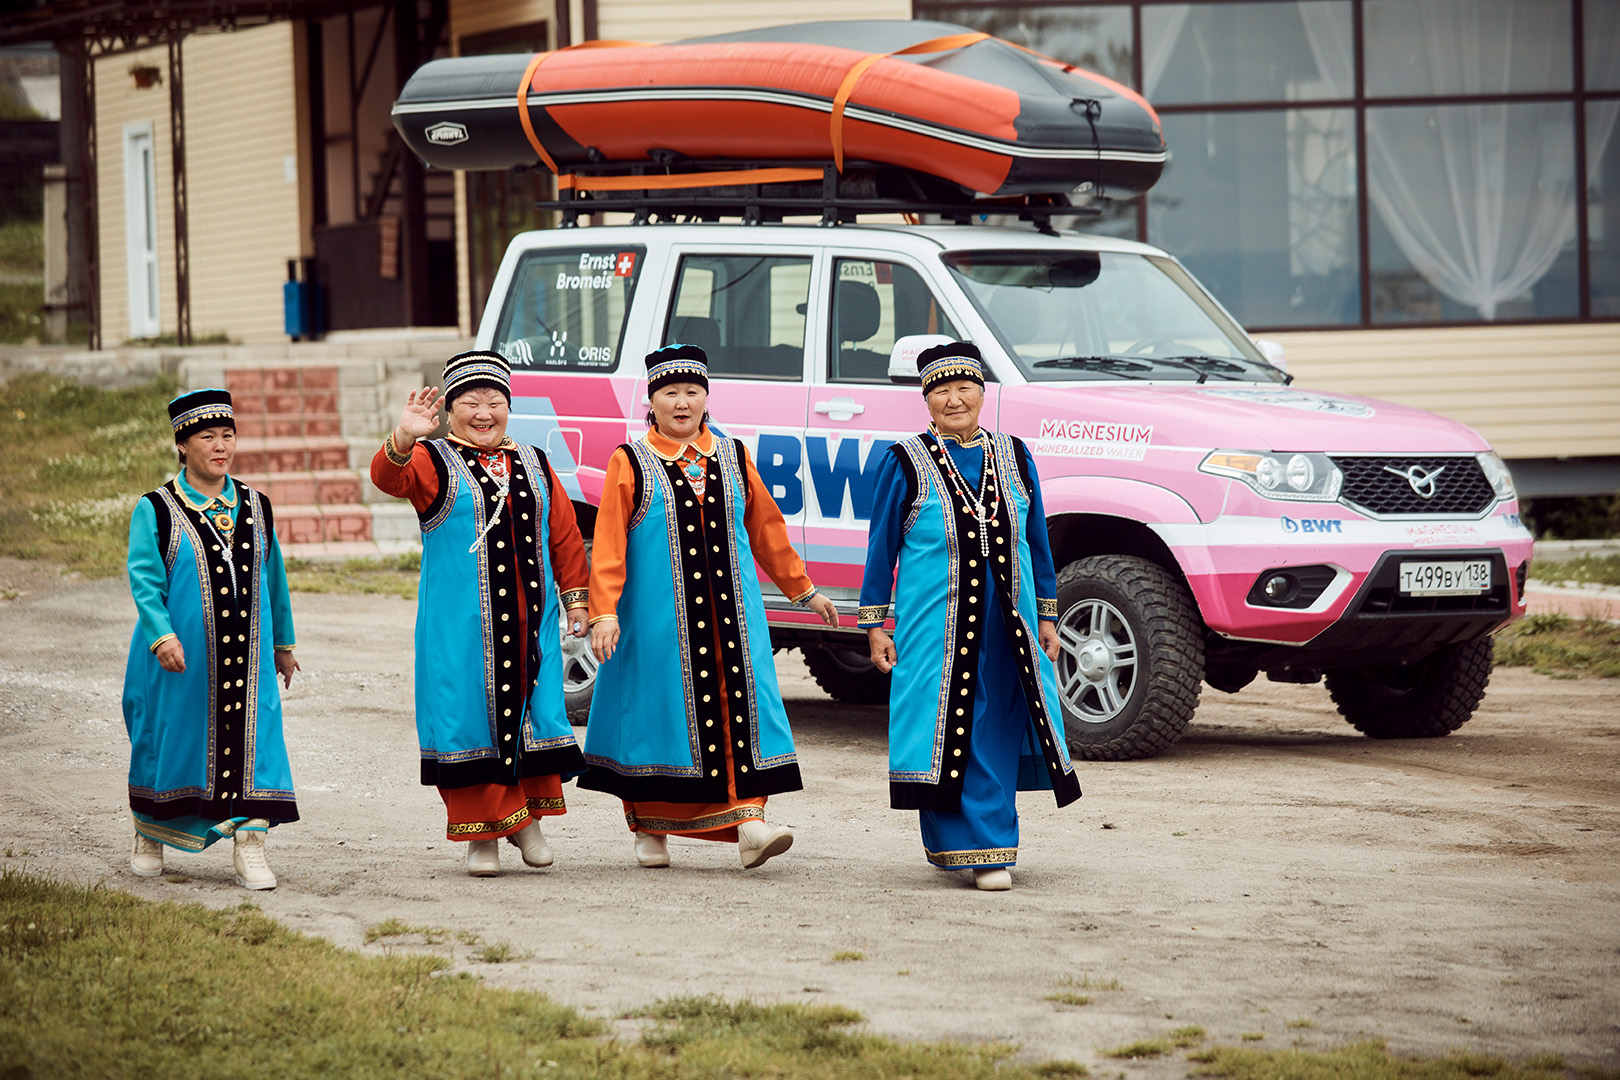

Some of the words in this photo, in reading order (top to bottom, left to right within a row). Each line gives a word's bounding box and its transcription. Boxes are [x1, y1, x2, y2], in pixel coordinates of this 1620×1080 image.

[579, 252, 616, 270] Ernst
[556, 271, 613, 290] Bromeis
[578, 346, 611, 361] ORIS
[1042, 422, 1151, 443] MAGNESIUM
[1036, 443, 1104, 456] MINERALIZED
[1106, 447, 1143, 459] WATER
[756, 434, 897, 519] BW
[1301, 519, 1342, 533] BWT
[1465, 564, 1488, 581] 138
